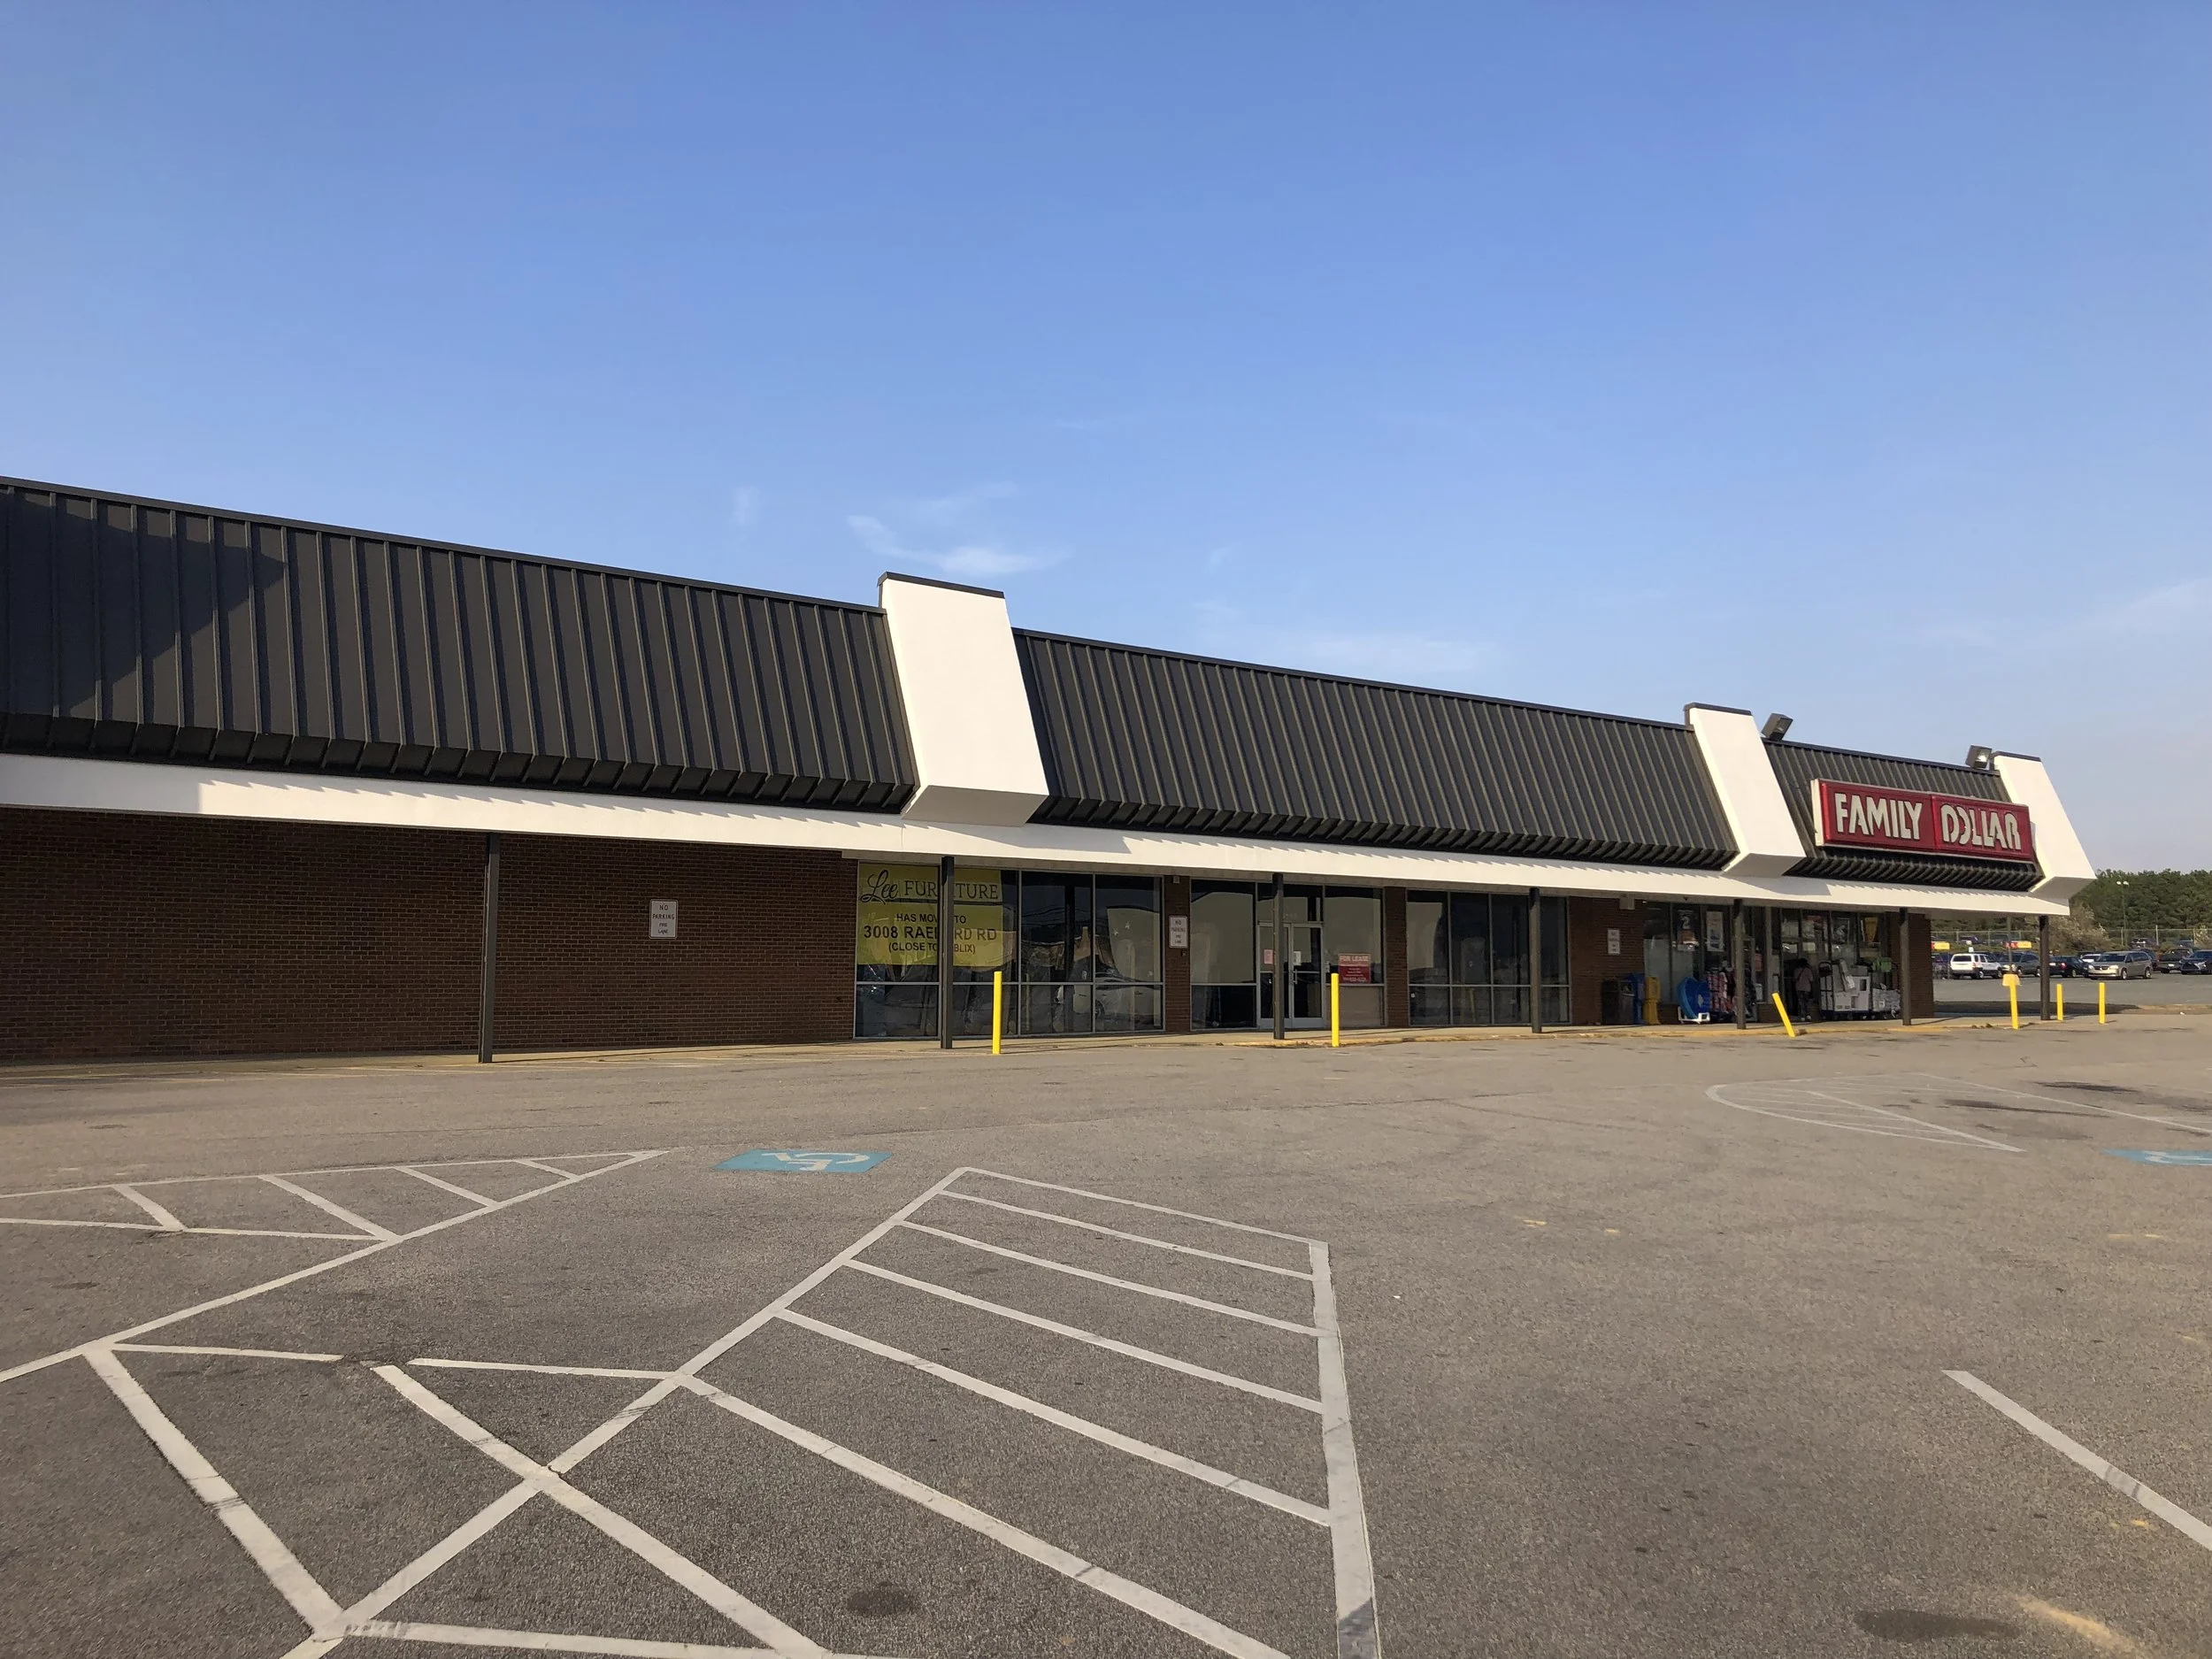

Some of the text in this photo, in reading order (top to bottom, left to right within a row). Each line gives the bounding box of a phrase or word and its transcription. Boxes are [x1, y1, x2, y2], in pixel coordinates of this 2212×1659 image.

[1833, 793, 2022, 850] FAMILY DOLLAR
[860, 869, 999, 904] Lee FURTURE
[896, 913, 917, 922] HAS
[954, 915, 966, 924] TO
[864, 926, 997, 941] 3008 RAERD RD
[888, 941, 926, 953] (CLOSE
[953, 944, 976, 955] BLIX)
